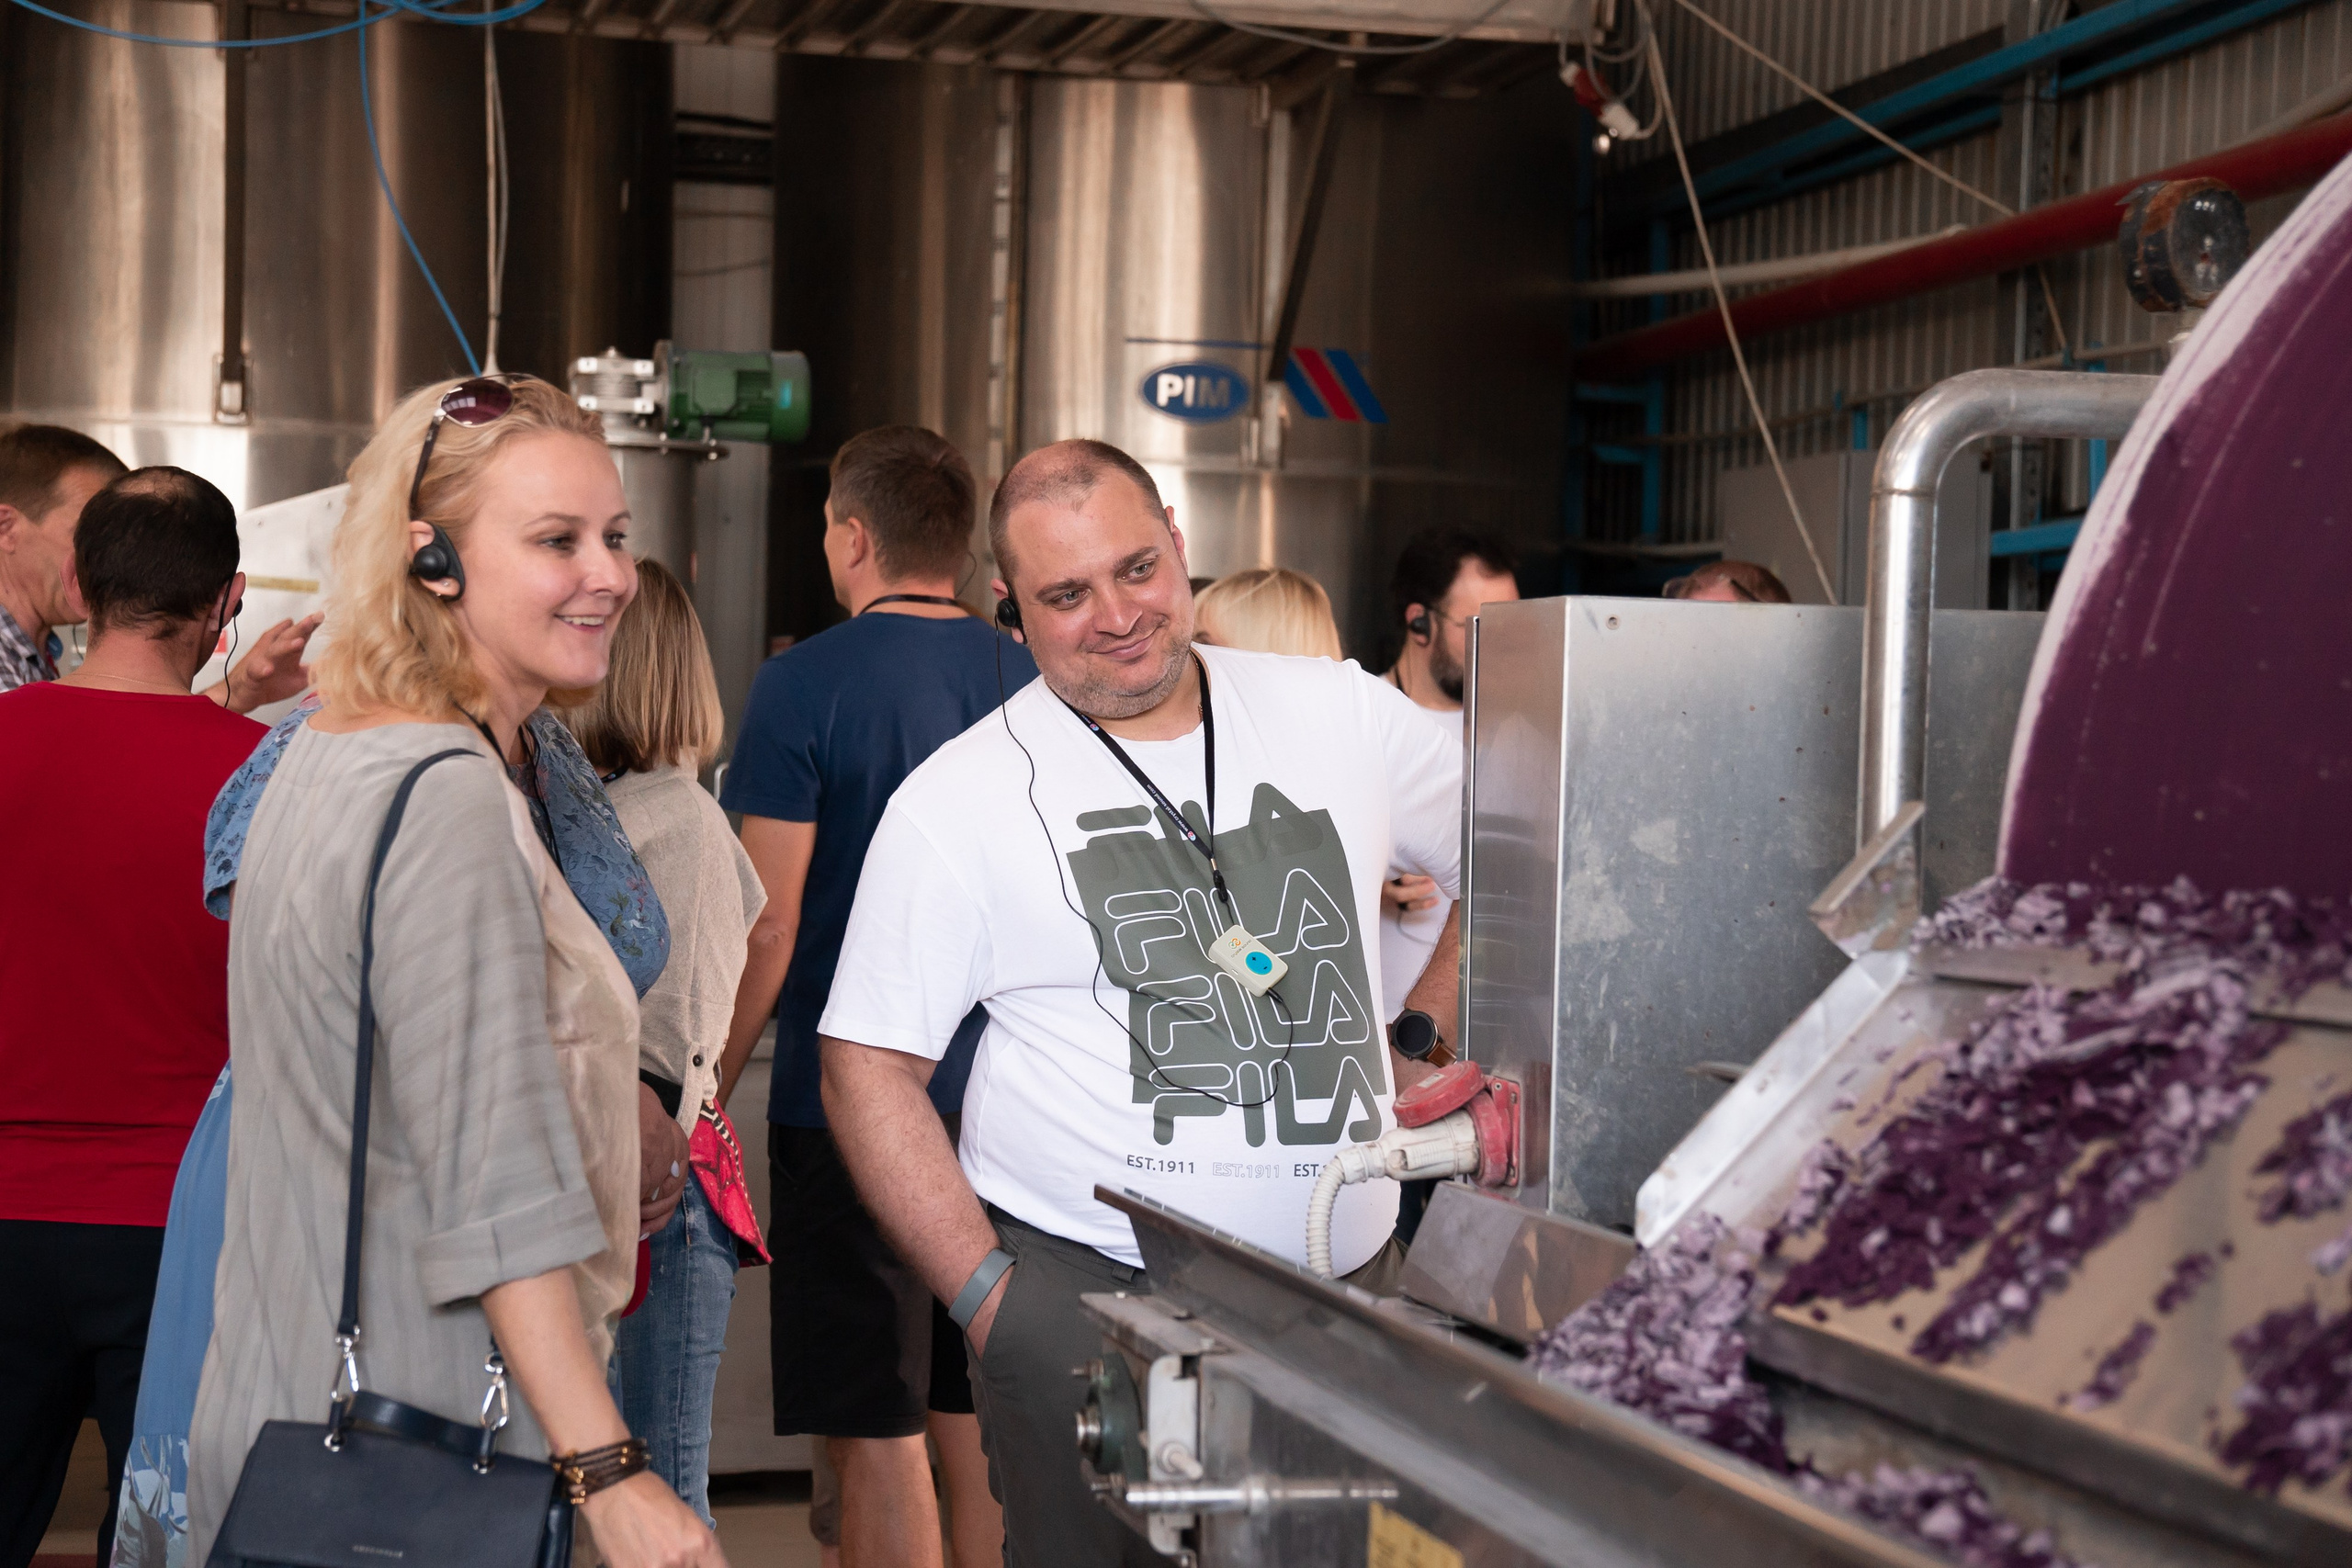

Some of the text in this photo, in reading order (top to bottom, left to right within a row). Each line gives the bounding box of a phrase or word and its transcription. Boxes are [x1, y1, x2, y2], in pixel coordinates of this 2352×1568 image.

[1156, 373, 1230, 408] PIM
[1136, 959, 1370, 1055] FILA
[1148, 1055, 1383, 1148] FILA
[1126, 1154, 1195, 1174] EST.1911
[1212, 1161, 1281, 1179] EST.1911
